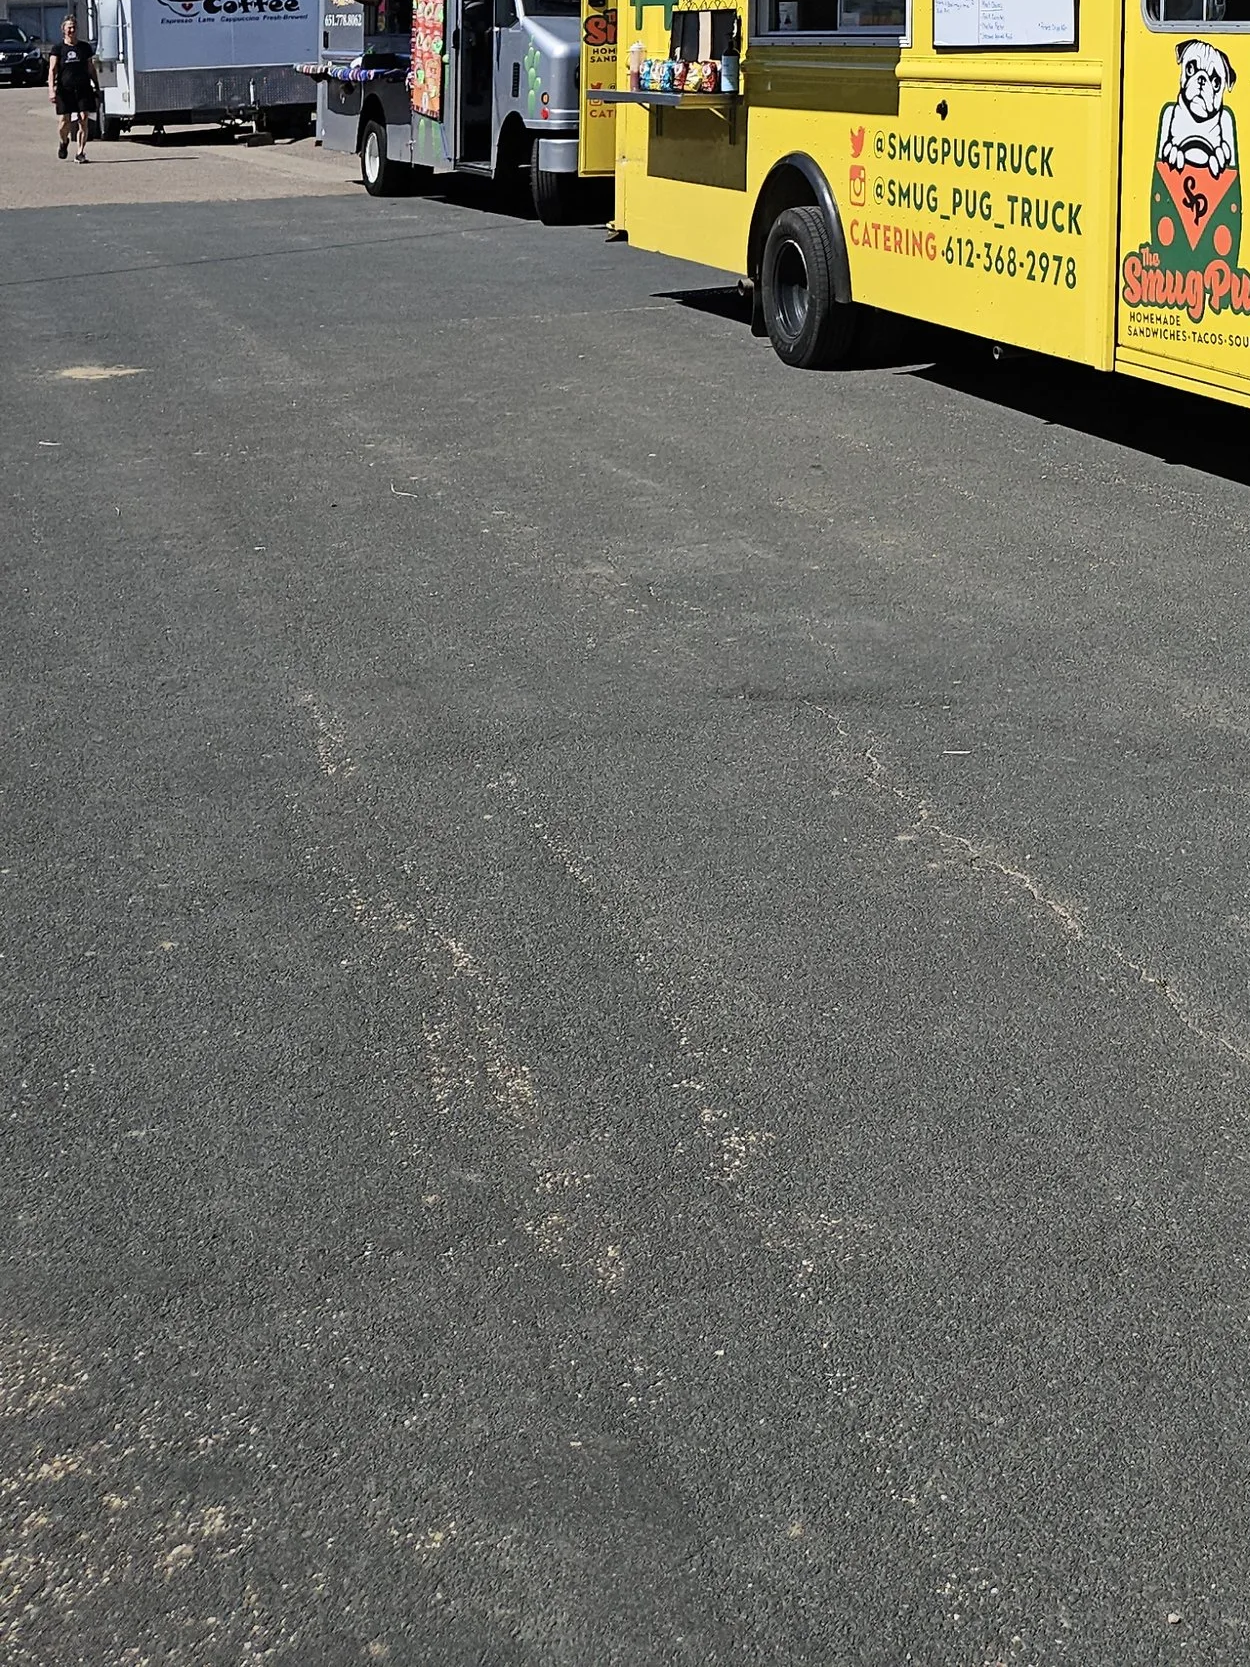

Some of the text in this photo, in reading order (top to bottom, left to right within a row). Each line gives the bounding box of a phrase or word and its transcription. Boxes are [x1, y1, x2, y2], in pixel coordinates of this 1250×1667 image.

[873, 130, 1054, 178] @SMUGPUGTRUCK
[873, 176, 1082, 236] @SMUG_PUG_TRUCK
[849, 218, 937, 261] CATERING
[1139, 246, 1160, 267] The
[1122, 254, 1206, 321] Smug
[1129, 311, 1181, 327] HOMEMADE
